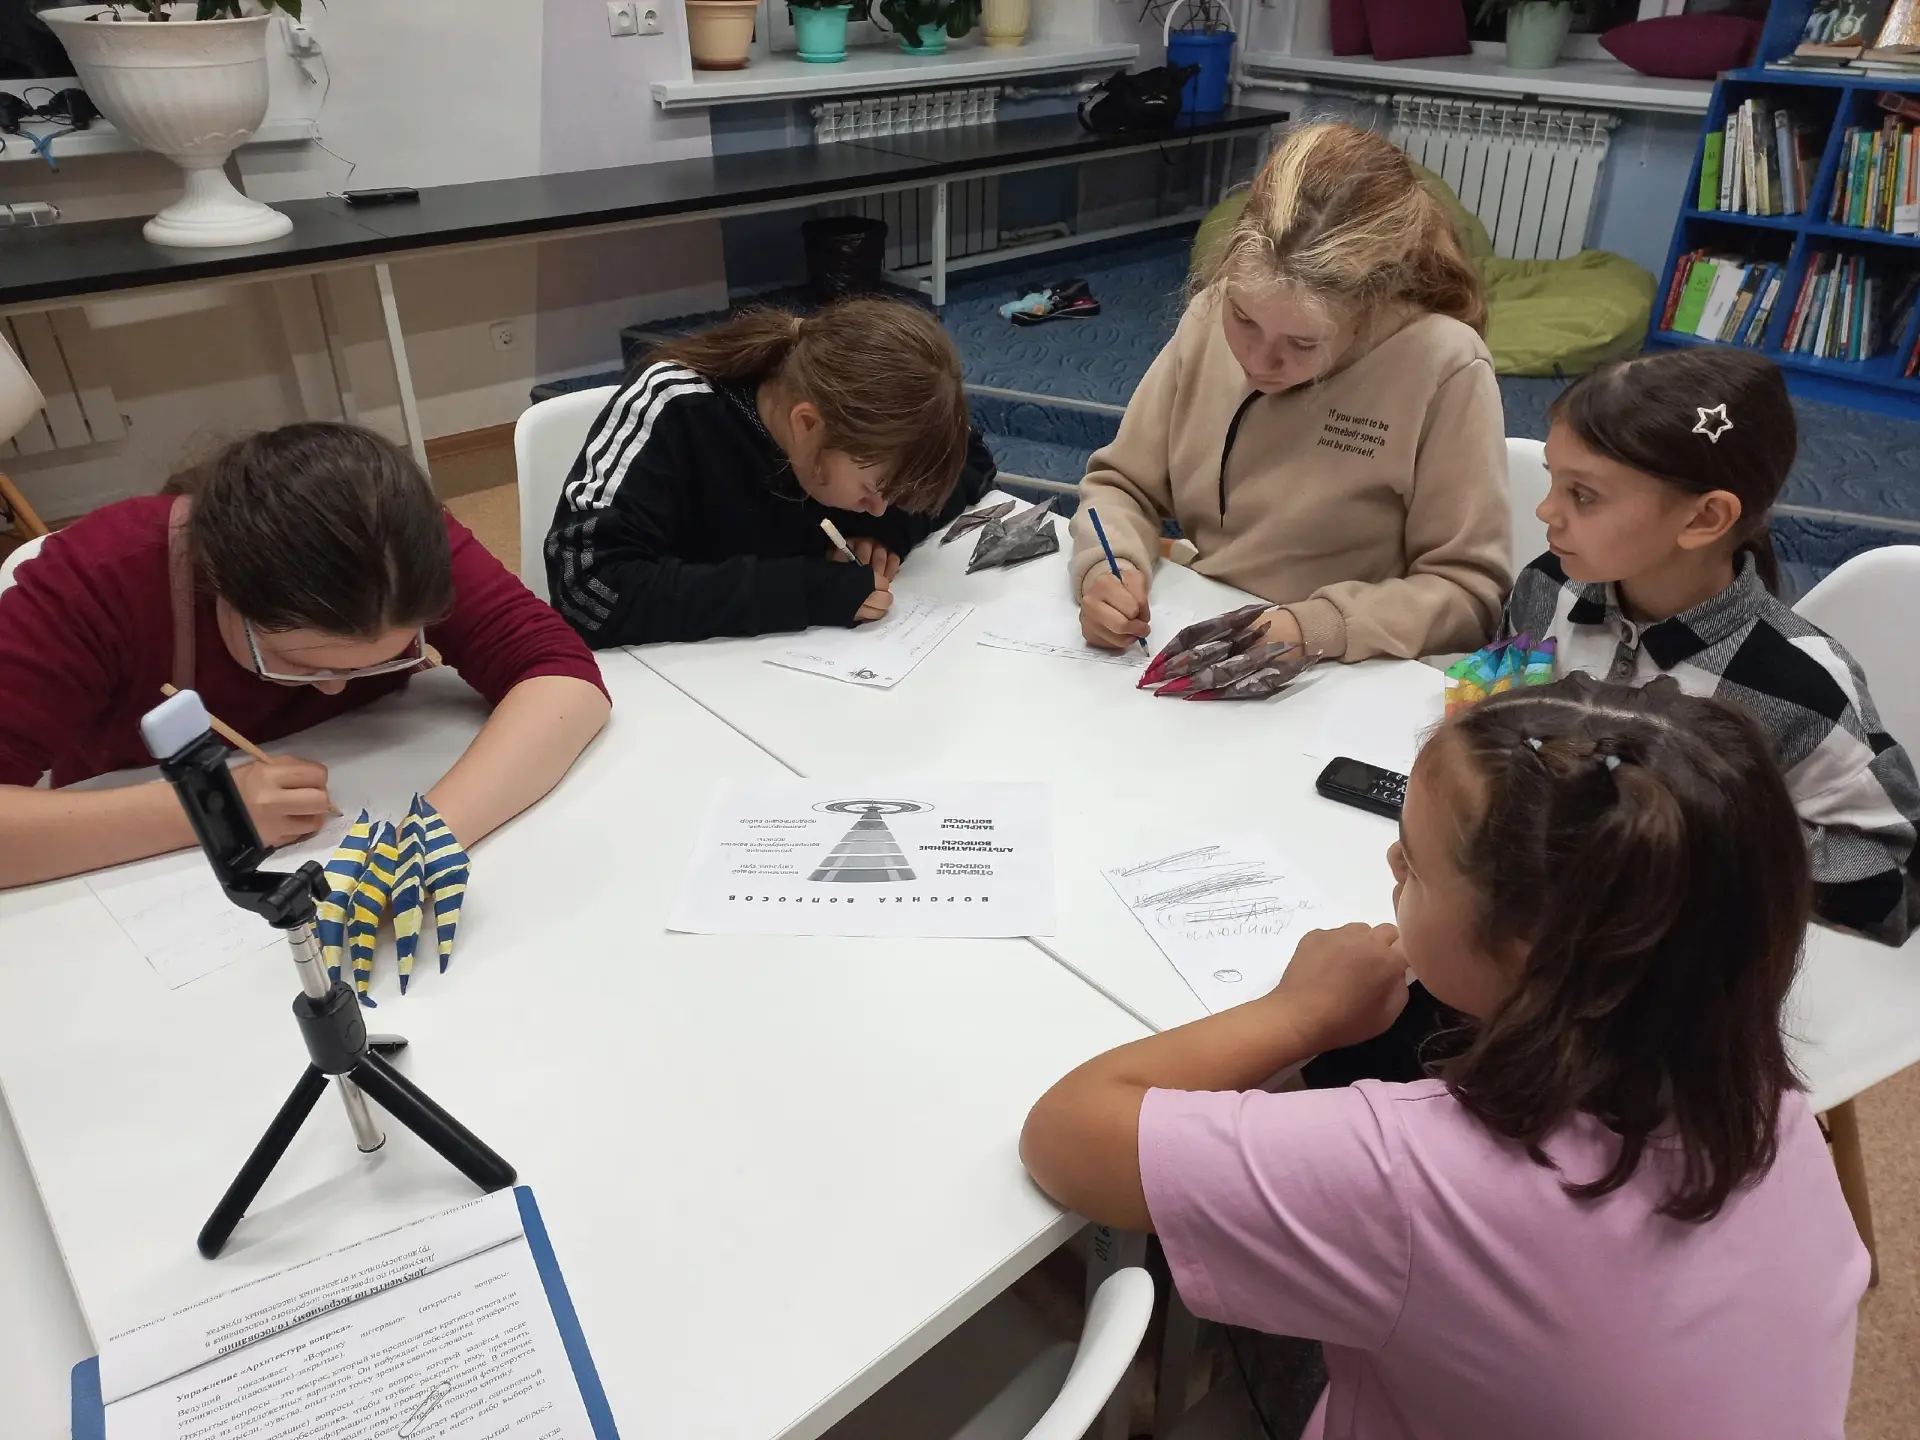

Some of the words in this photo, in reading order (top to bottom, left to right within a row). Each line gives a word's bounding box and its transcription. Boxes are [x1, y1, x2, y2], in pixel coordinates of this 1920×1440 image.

[1324, 423, 1360, 440] somebody
[1335, 412, 1351, 422] you
[1369, 419, 1377, 428] to
[1378, 420, 1389, 431] be
[1317, 435, 1334, 448] just
[1334, 440, 1343, 450] be
[918, 844, 1013, 852] АЛЬТЕРНАТИВНЫЕ
[728, 894, 854, 903] ВОПРОСОВ
[359, 1246, 430, 1276] труднодоступных
[389, 1253, 434, 1275] Документы
[299, 1277, 348, 1299] отдаленных
[323, 1277, 374, 1301] проведению
[369, 1262, 427, 1296] Документы
[173, 1294, 223, 1315] досрочного
[355, 1287, 366, 1300] по
[245, 1297, 296, 1320] населенных
[271, 1297, 319, 1320] досрочного
[292, 1292, 352, 1326] досрочному
[110, 1317, 165, 1341] голосования
[206, 1319, 242, 1336] пунктах
[214, 1318, 268, 1344] голосования
[217, 1319, 289, 1355] голосованию
[177, 1373, 237, 1402] Упражнение
[241, 1344, 306, 1374] «Архитектура
[310, 1325, 353, 1345] вопроса».
[178, 1395, 220, 1417] Ведущий
[238, 1367, 286, 1392] показывает
[304, 1341, 345, 1362] «Воронку
[419, 1292, 460, 1313] (открытые
[180, 1419, 228, 1440] Открытые
[232, 1400, 270, 1420] вопросы
[281, 1390, 294, 1399] это
[297, 1375, 330, 1391] вопрос,
[333, 1356, 368, 1376] который
[383, 1327, 436, 1353] предполагает
[440, 1311, 474, 1329] краткого
[476, 1299, 501, 1312] ответа
[503, 1292, 516, 1300] или
[235, 1397, 301, 1430] предложенных
[307, 1376, 351, 1398] вариантов.
[358, 1367, 370, 1375] Он
[375, 1345, 417, 1368] побуждает
[423, 1322, 473, 1346] собеседника
[265, 1409, 302, 1427] чувства,
[305, 1396, 327, 1409] опыт
[331, 1388, 346, 1398] или
[349, 1377, 372, 1389] точку
[376, 1362, 404, 1378] зрения
[407, 1348, 436, 1364] своими
[439, 1332, 472, 1349] словами.
[316, 1401, 353, 1421] вопросы
[371, 1388, 383, 1396] это
[427, 1352, 460, 1371] который
[504, 1322, 526, 1334] после
[353, 1400, 379, 1414] чтобы
[385, 1384, 415, 1400] глубже
[420, 1365, 458, 1386] раскрыть
[465, 1353, 484, 1364] тему,
[375, 1406, 390, 1416] или
[501, 1340, 532, 1357] отличие
[370, 1414, 397, 1430] новую
[480, 1348, 535, 1378] фокусируется
[479, 1403, 498, 1416] либо
[503, 1385, 532, 1403] выбора
[374, 1424, 400, 1438] более
[445, 1387, 477, 1405] полную
[480, 1369, 513, 1388] картину.
[451, 1398, 486, 1419] краткий,
[516, 1401, 553, 1425] вопрос-2
